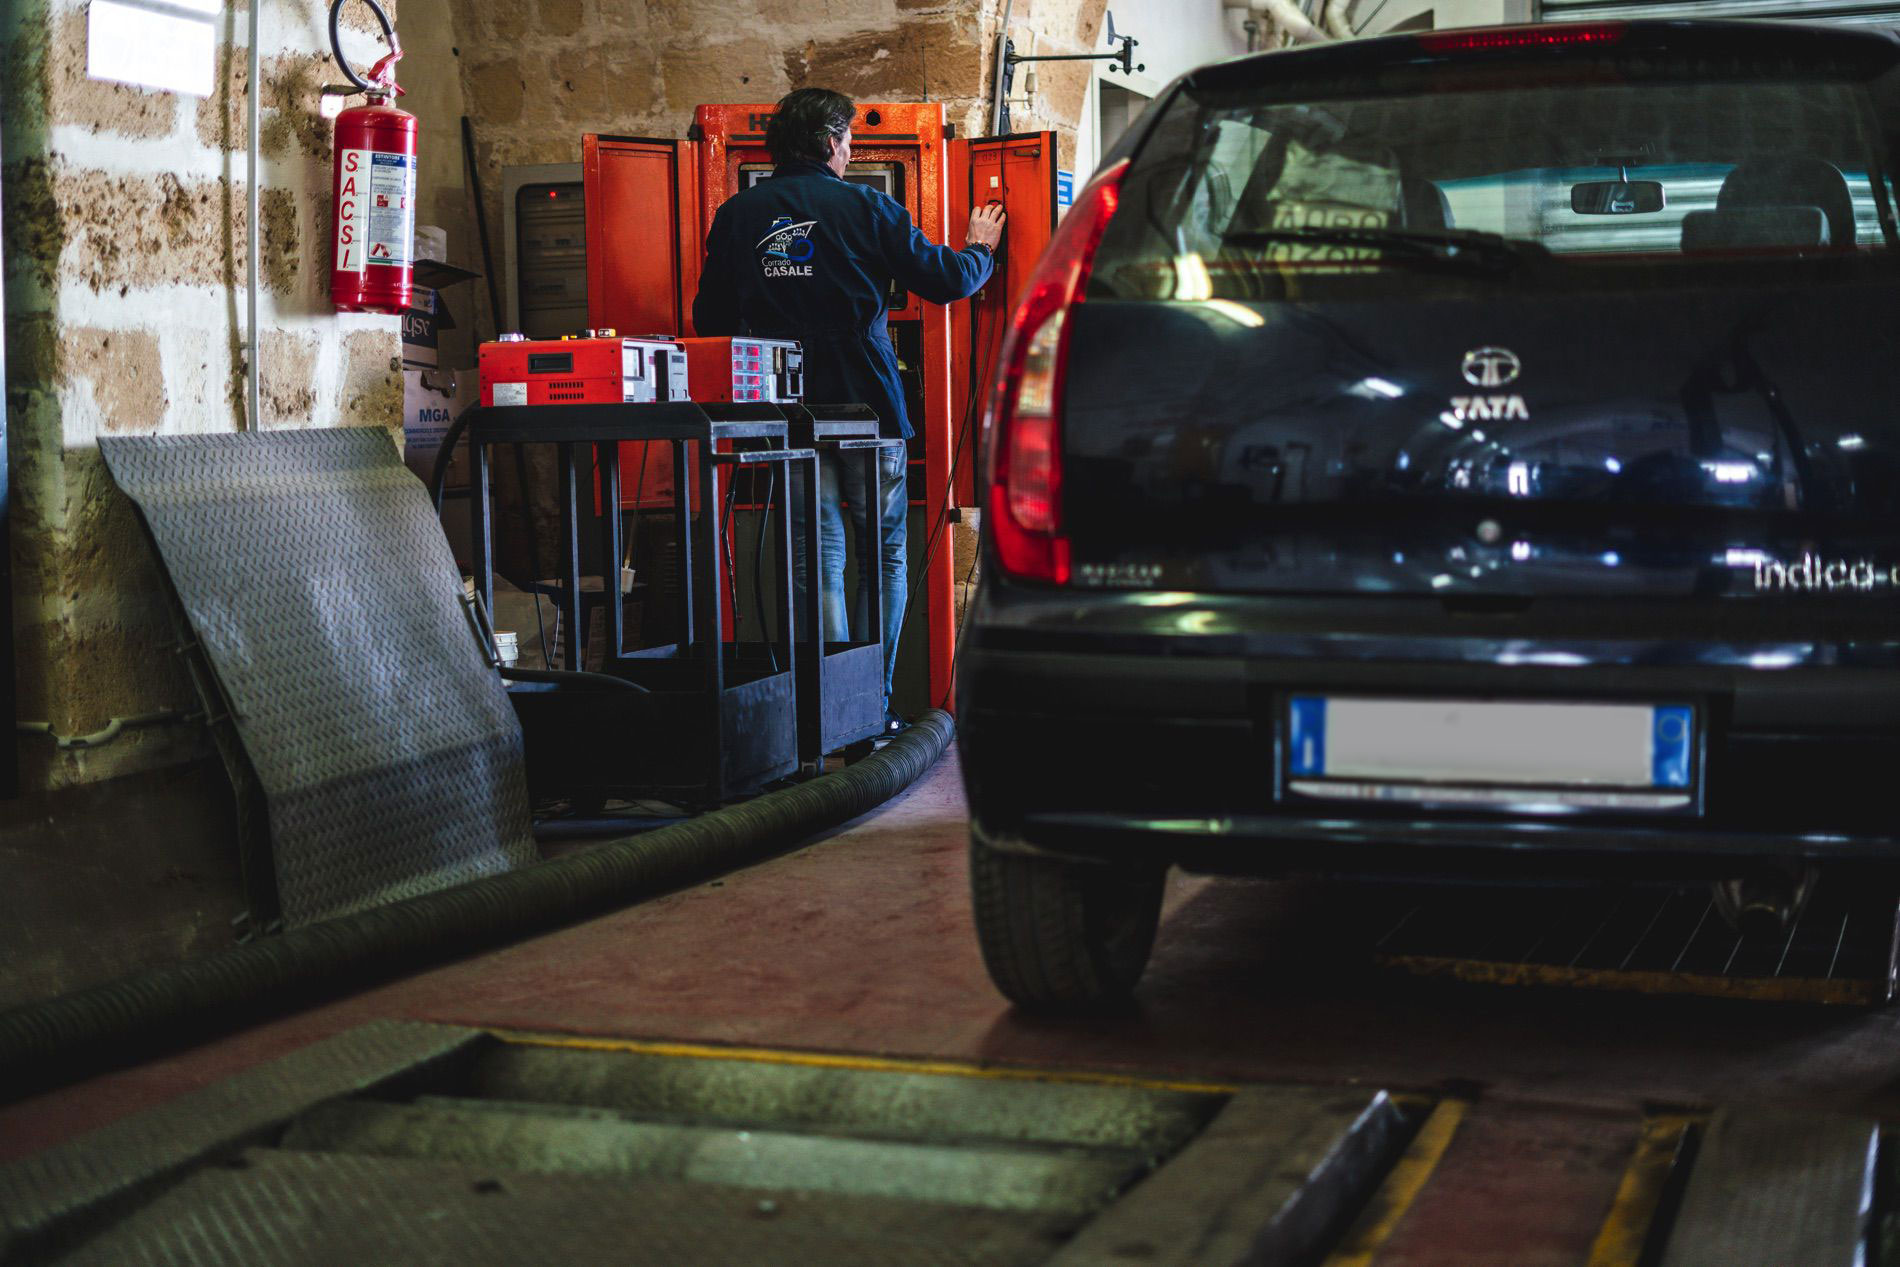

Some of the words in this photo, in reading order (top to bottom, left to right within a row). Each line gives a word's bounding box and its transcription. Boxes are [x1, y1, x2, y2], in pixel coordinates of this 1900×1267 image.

[761, 257, 792, 267] Corrado
[764, 265, 814, 277] CASALE
[1450, 396, 1529, 420] TATA
[418, 408, 450, 422] MGA
